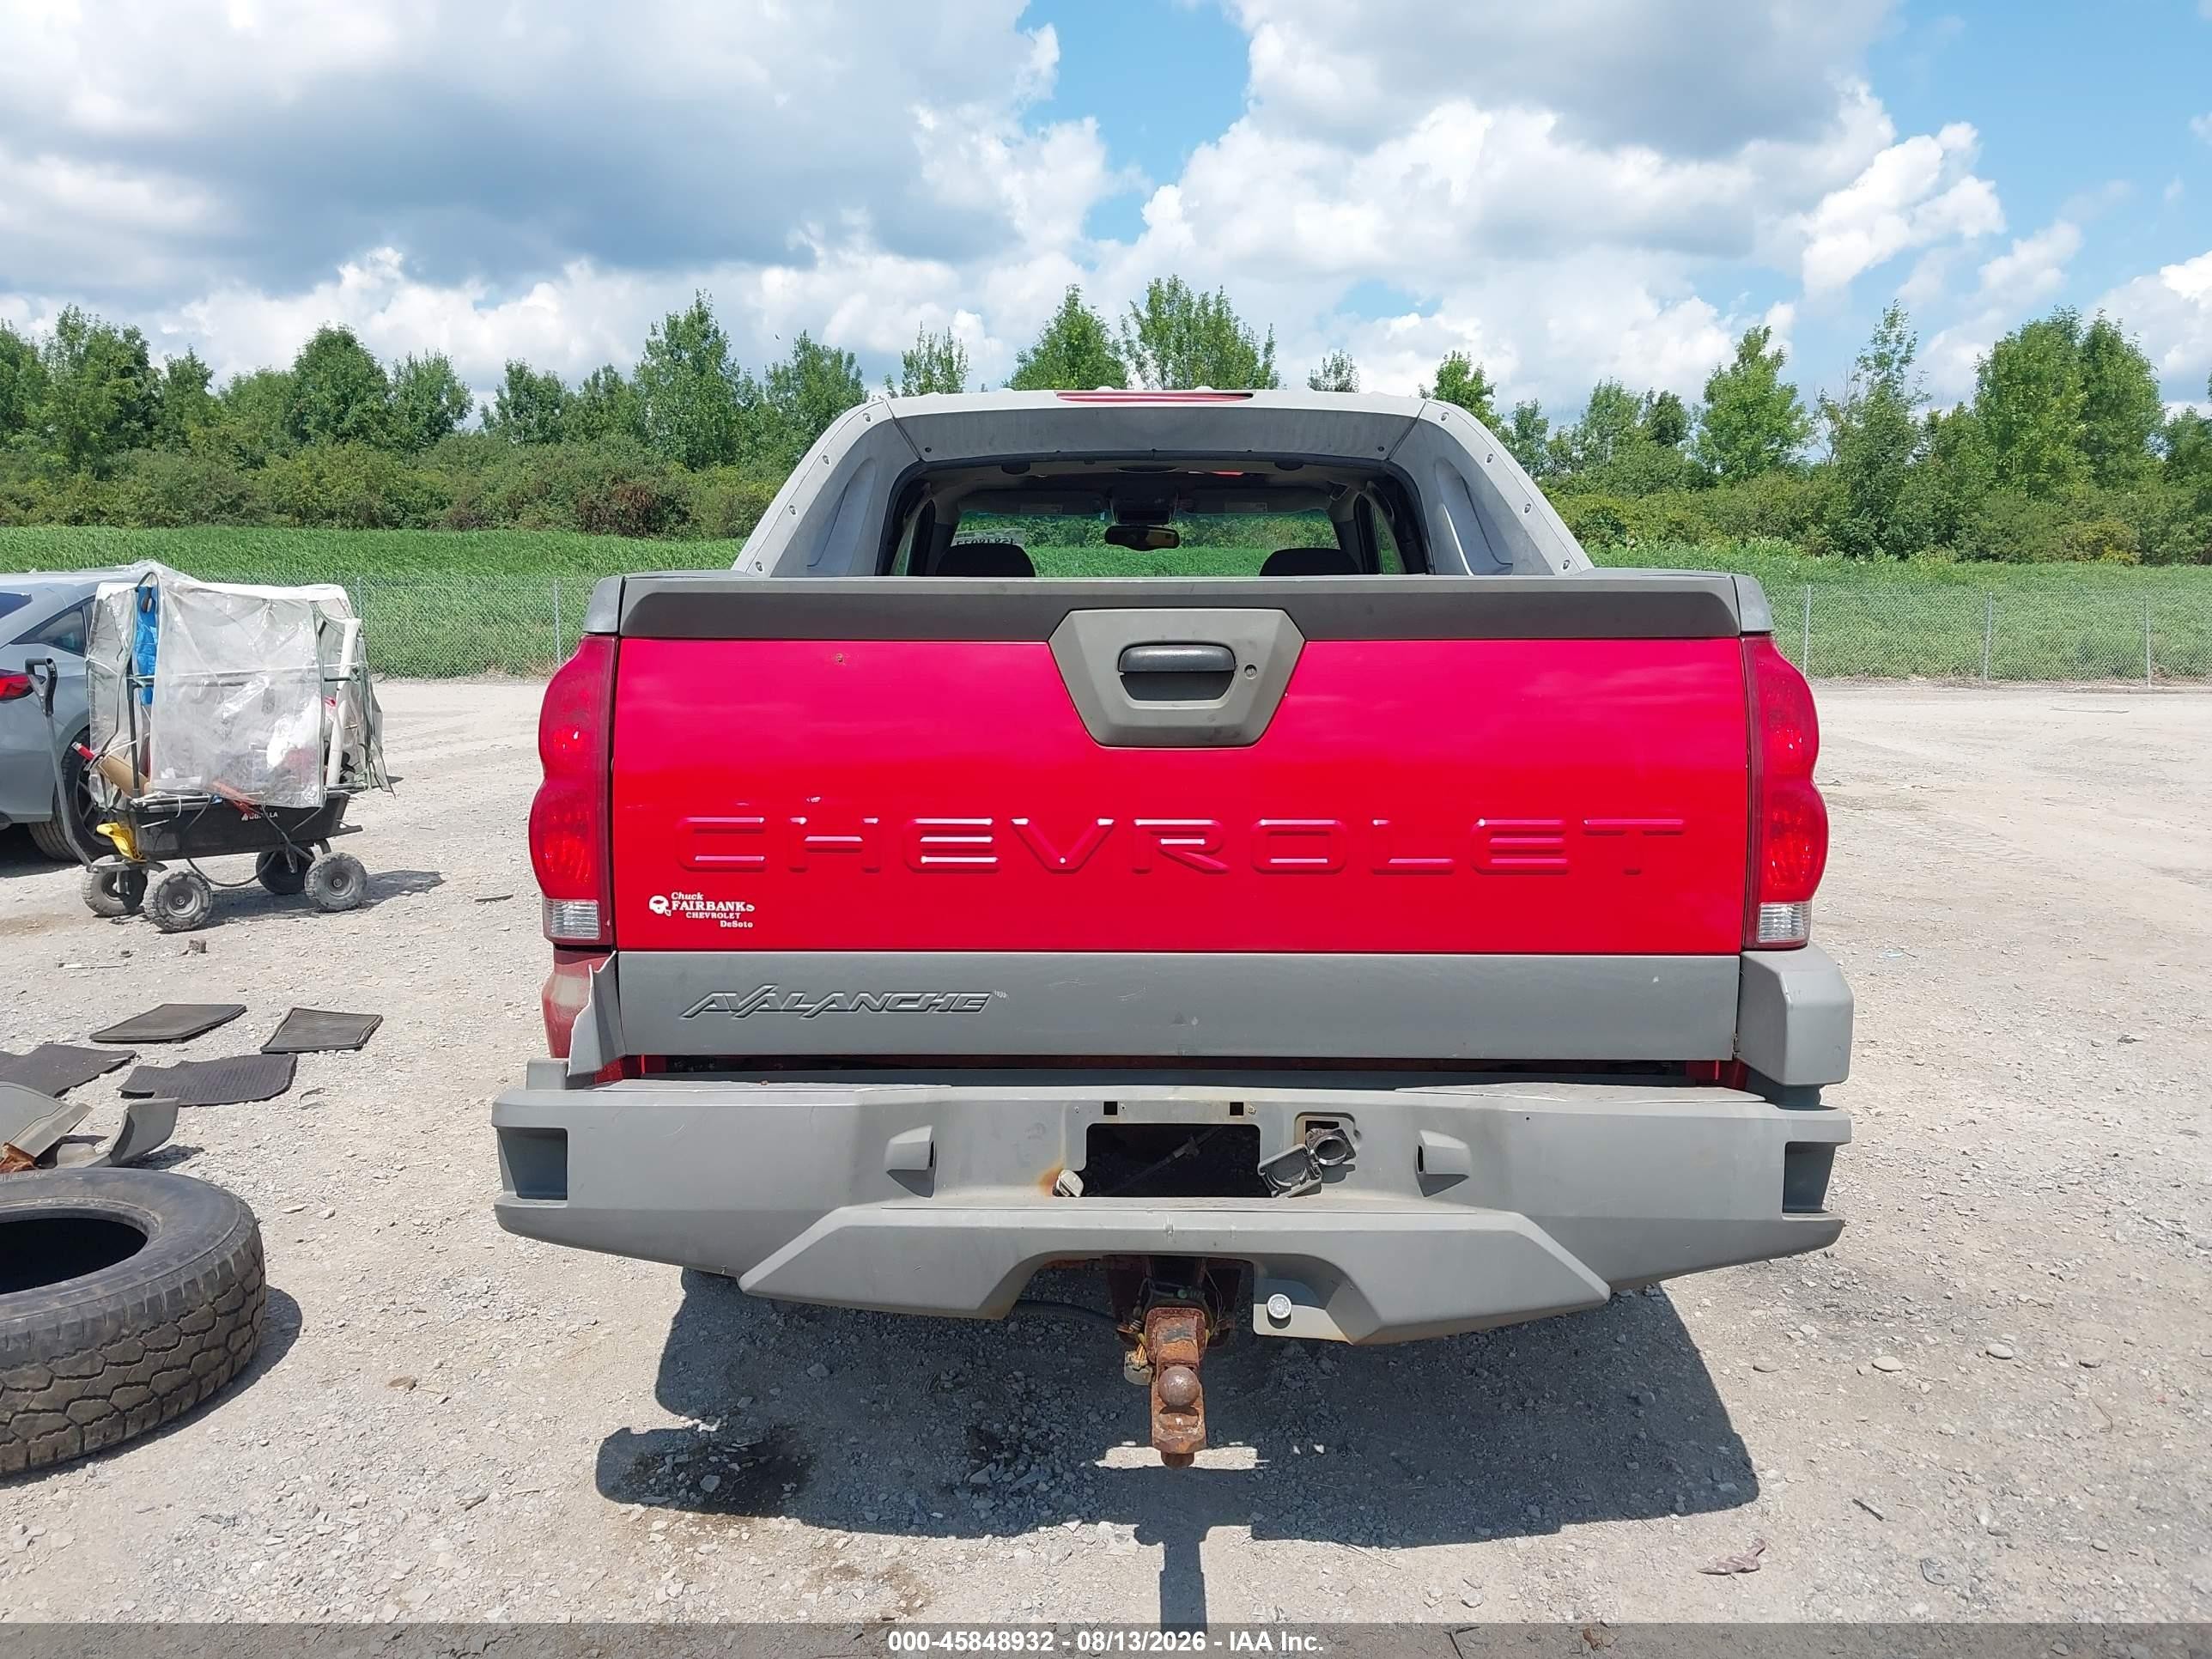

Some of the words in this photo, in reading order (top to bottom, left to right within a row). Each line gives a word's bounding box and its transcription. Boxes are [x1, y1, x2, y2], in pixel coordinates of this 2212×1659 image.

[677, 816, 1686, 875] CHEVROLET
[671, 891, 704, 901] Chuck
[685, 911, 741, 920] CHEVROLET
[720, 920, 753, 928] DeSoto
[679, 983, 993, 1020] AVALANCHE
